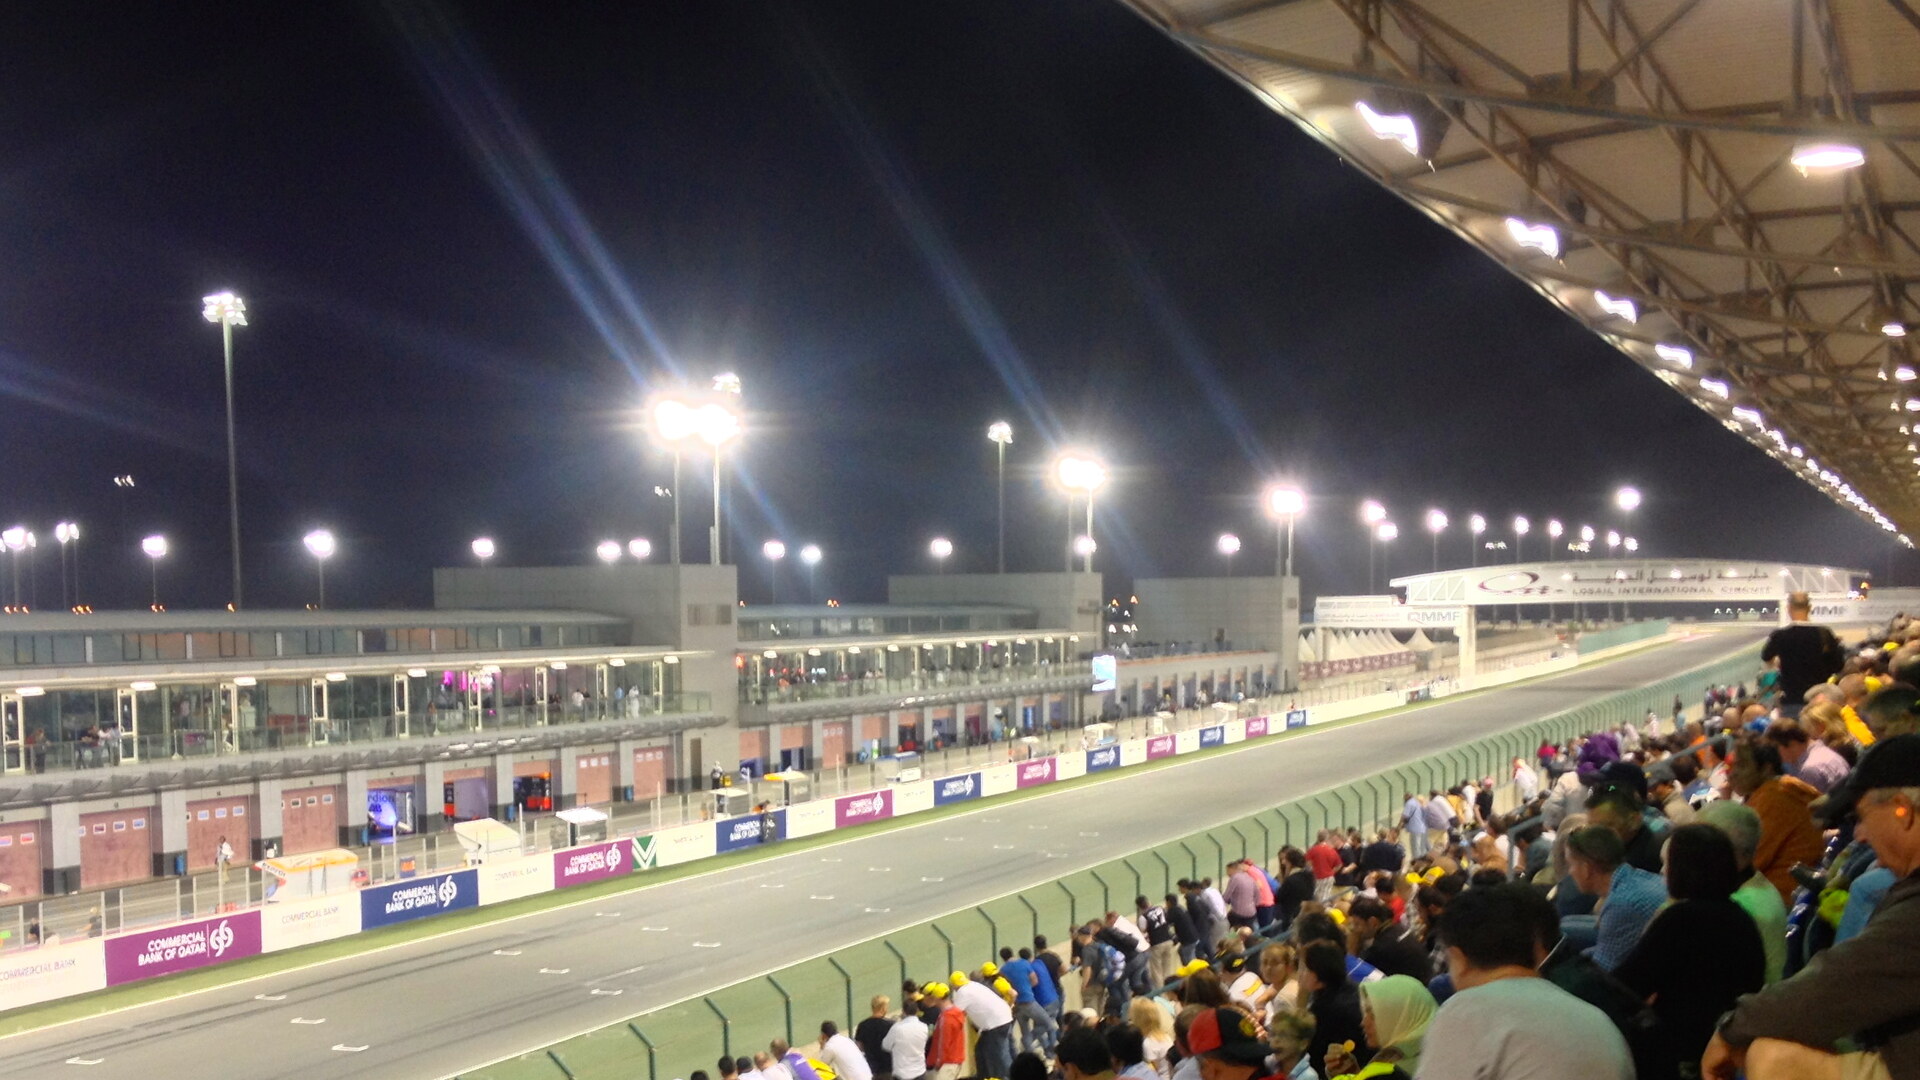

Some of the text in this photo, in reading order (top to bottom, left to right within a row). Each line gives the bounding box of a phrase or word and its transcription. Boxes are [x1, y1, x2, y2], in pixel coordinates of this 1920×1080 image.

[1572, 585, 1772, 595] LOSAIL INTERNATIONAL CIRCUIT
[1407, 611, 1461, 625] QMMF
[1810, 605, 1846, 616] MMF
[367, 791, 395, 803] rdion
[392, 884, 436, 902] COMMERCIAL
[385, 894, 437, 914] BANK OF QATAR
[147, 930, 206, 952] COMMERCIAL
[138, 942, 206, 966] BANK OF QATAR
